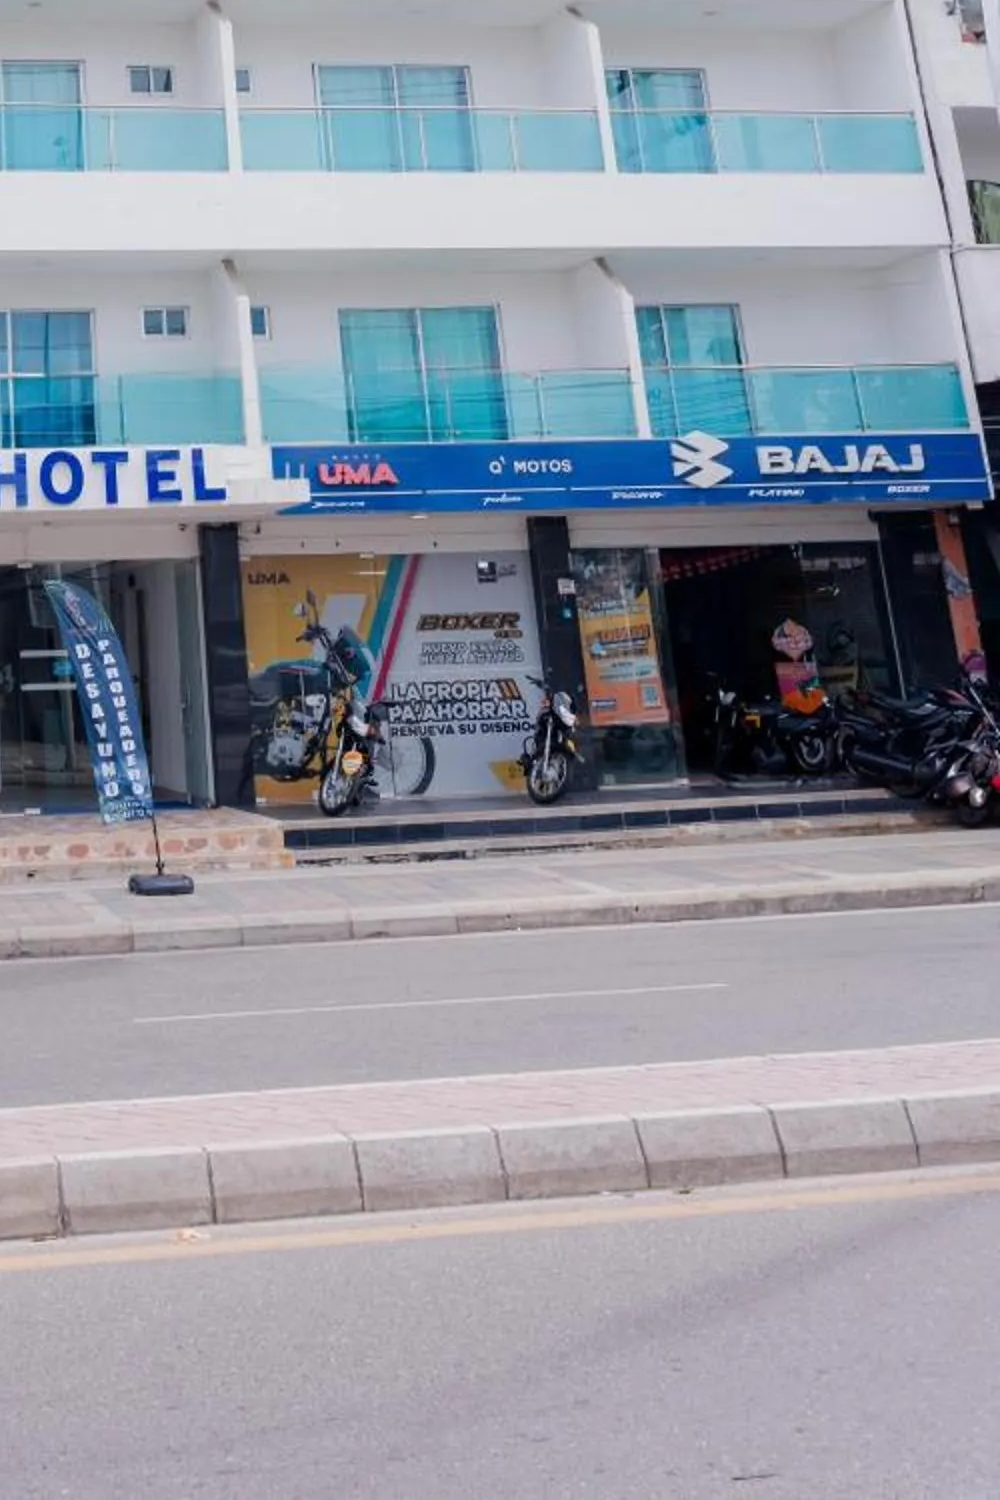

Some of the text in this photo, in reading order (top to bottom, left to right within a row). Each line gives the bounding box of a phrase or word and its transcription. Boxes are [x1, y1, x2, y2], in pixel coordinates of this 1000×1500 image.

[513, 459, 573, 473] MOTOS
[756, 444, 925, 475] BAJAJ
[318, 462, 399, 486] UMA
[248, 572, 291, 586] UMA
[416, 612, 521, 631] BOXER
[391, 681, 502, 701] LA PROPIA
[422, 700, 527, 719] AHORRAR
[457, 723, 477, 734] SU
